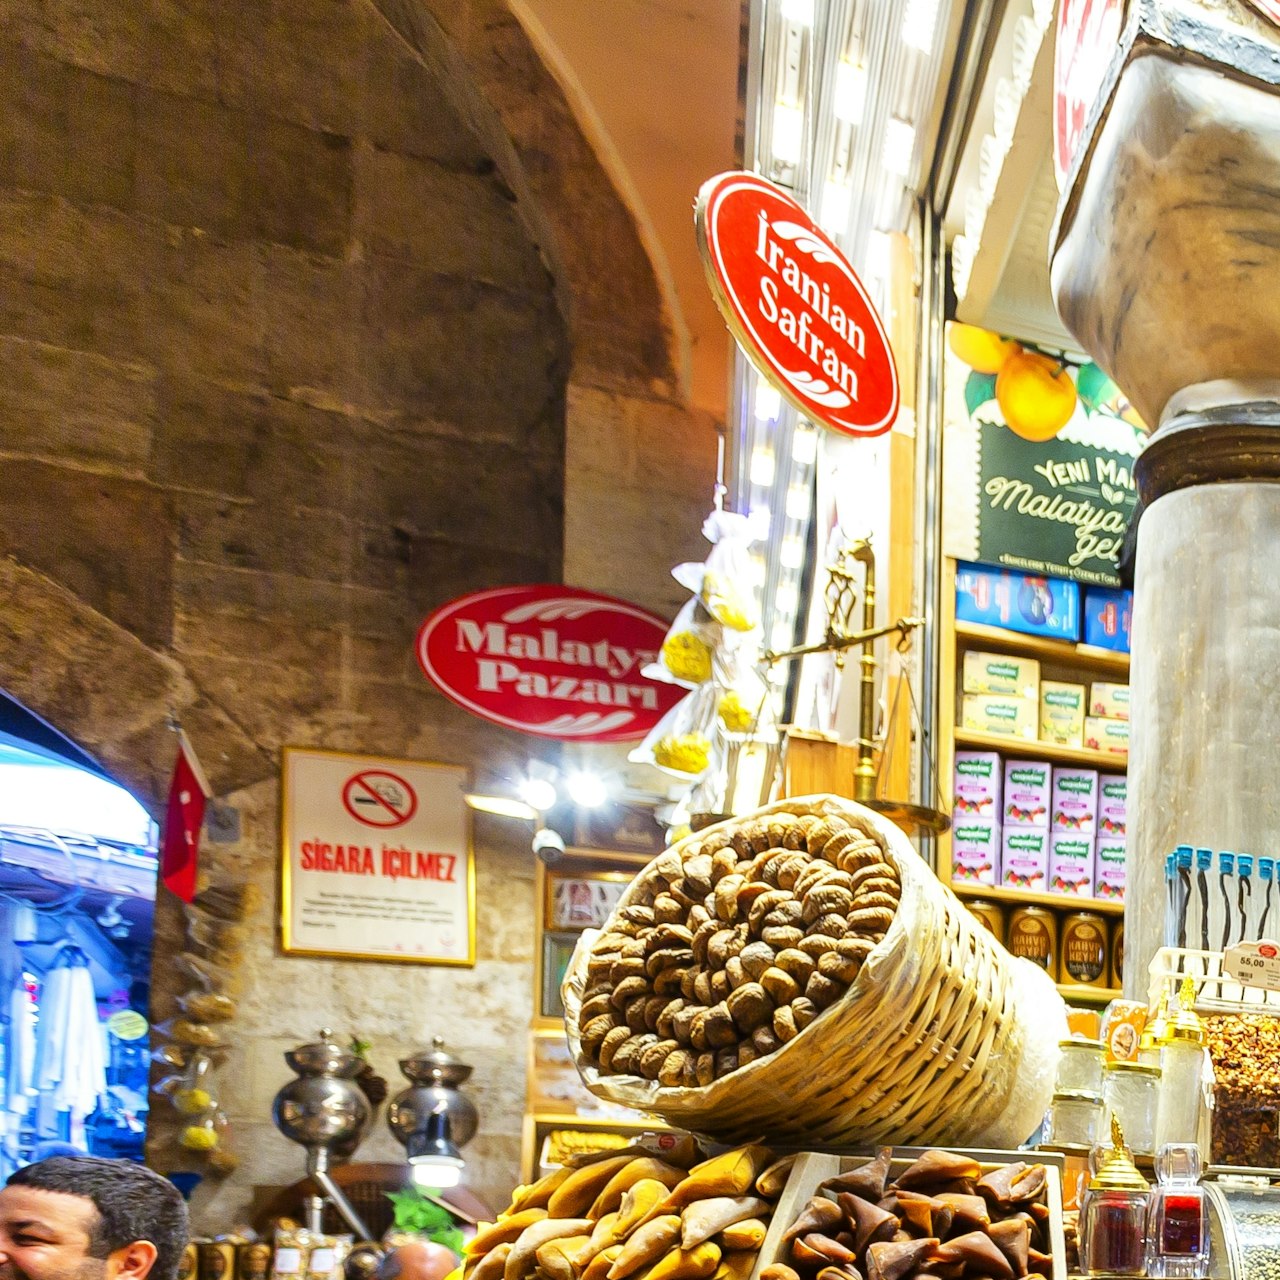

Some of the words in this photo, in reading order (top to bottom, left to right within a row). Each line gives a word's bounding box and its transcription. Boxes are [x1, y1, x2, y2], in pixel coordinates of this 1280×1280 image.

[755, 208, 866, 359] İranian
[759, 276, 859, 402] Safran
[984, 477, 1127, 540] Malatya
[476, 658, 658, 710] Pazarı
[300, 838, 375, 876] SİGARA
[381, 843, 456, 883] İÇİLMEZ
[1239, 956, 1265, 968] 55,00
